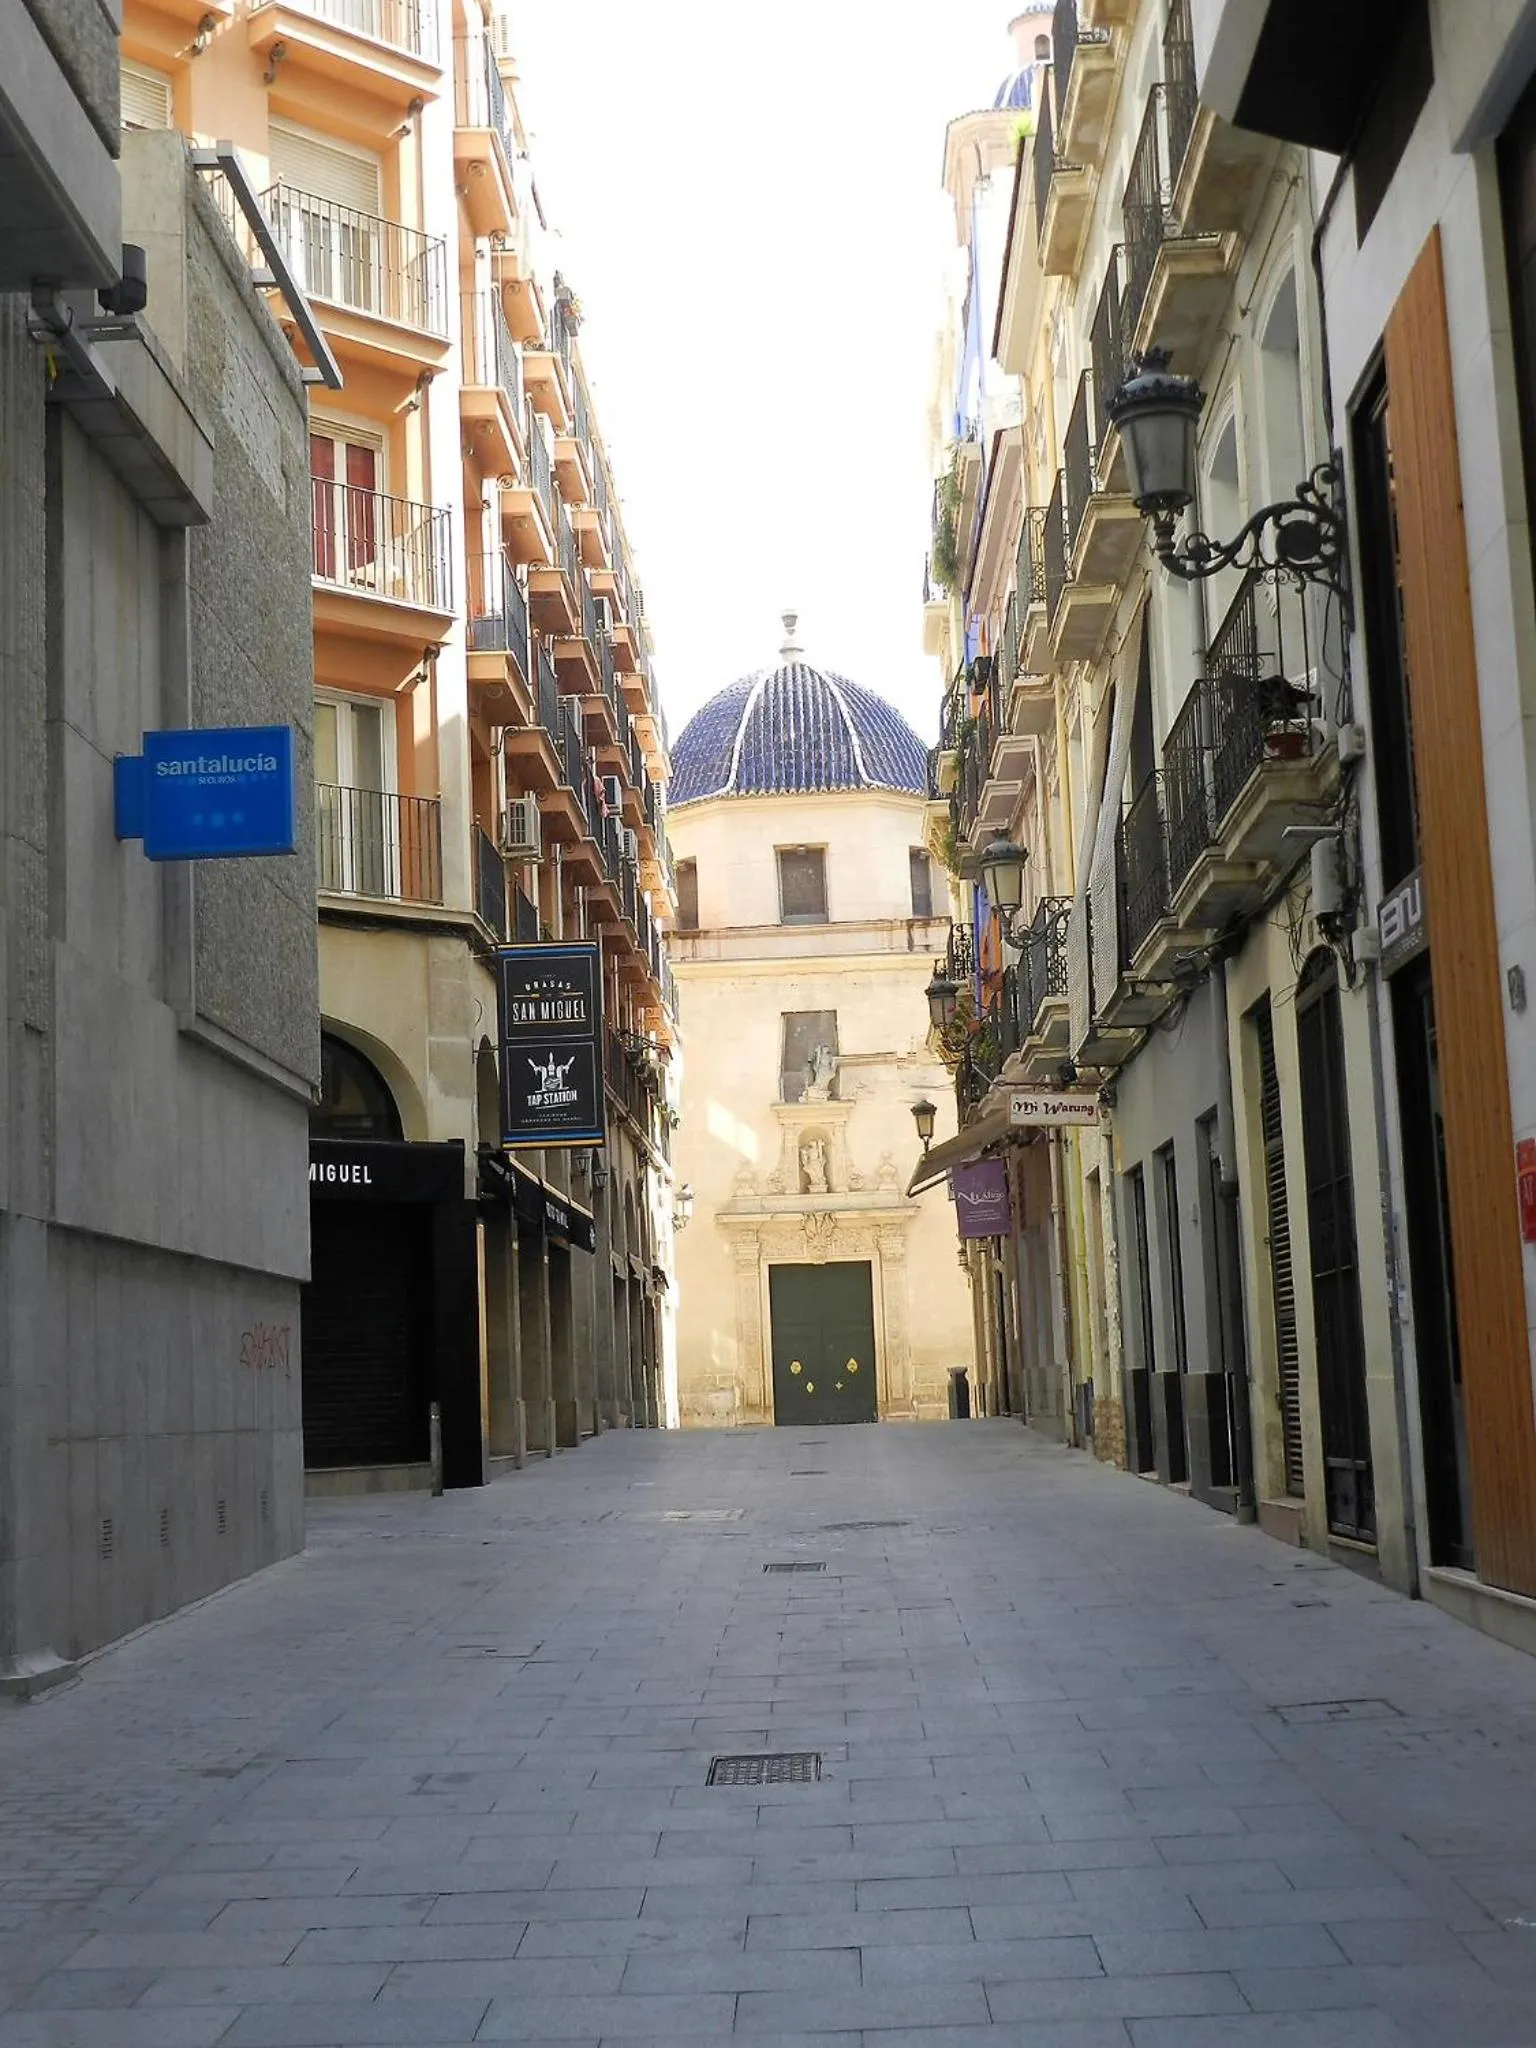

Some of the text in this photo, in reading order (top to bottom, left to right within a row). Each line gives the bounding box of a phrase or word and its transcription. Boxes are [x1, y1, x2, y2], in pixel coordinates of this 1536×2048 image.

[156, 753, 277, 777] santalucía
[512, 999, 586, 1021] SAN MIGUEL
[526, 1090, 577, 1107] TAP STATION
[1012, 1101, 1095, 1116] Mi Warung
